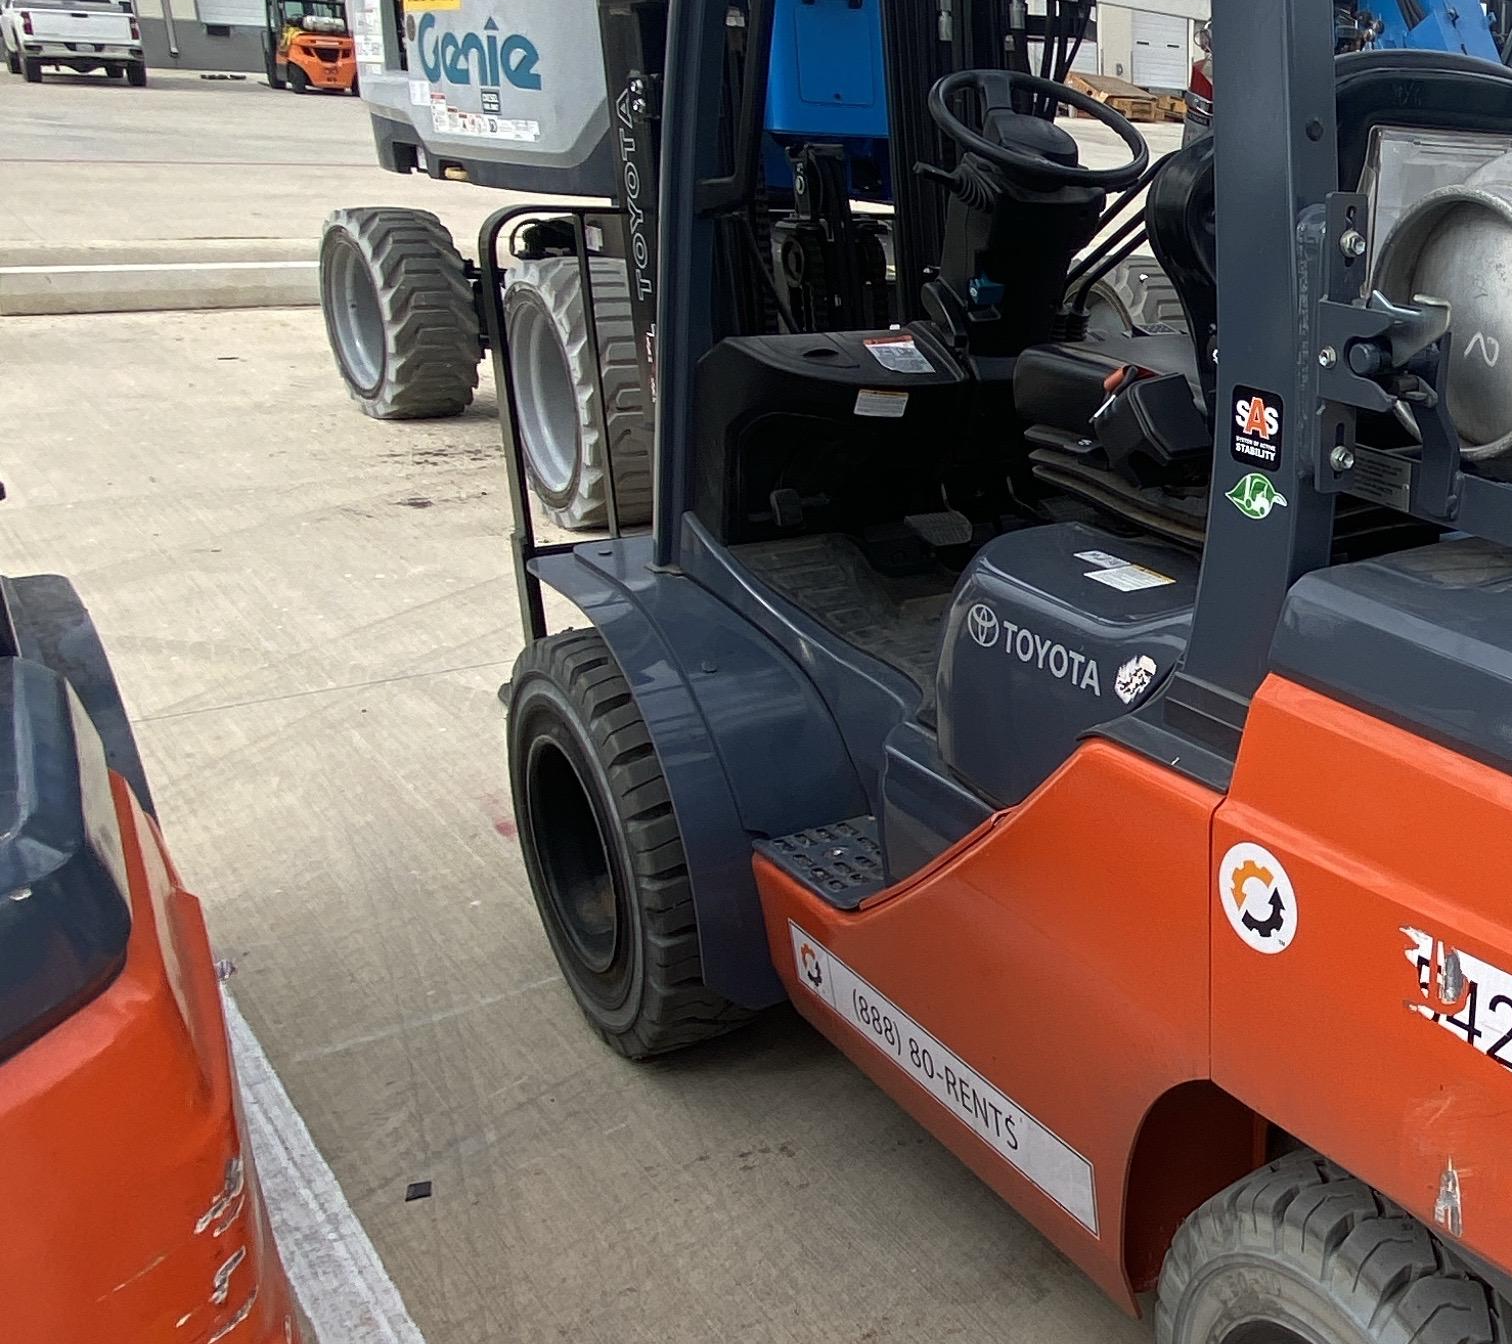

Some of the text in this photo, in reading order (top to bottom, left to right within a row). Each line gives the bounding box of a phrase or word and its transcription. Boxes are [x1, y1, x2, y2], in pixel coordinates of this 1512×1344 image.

[417, 11, 542, 91] Genie
[615, 87, 653, 301] TOYOTA
[1235, 396, 1279, 441] SAS
[1235, 443, 1276, 462] STABILITY
[1003, 620, 1101, 697] TOYOTA
[851, 987, 1020, 1151] (888) 80-RENTS
